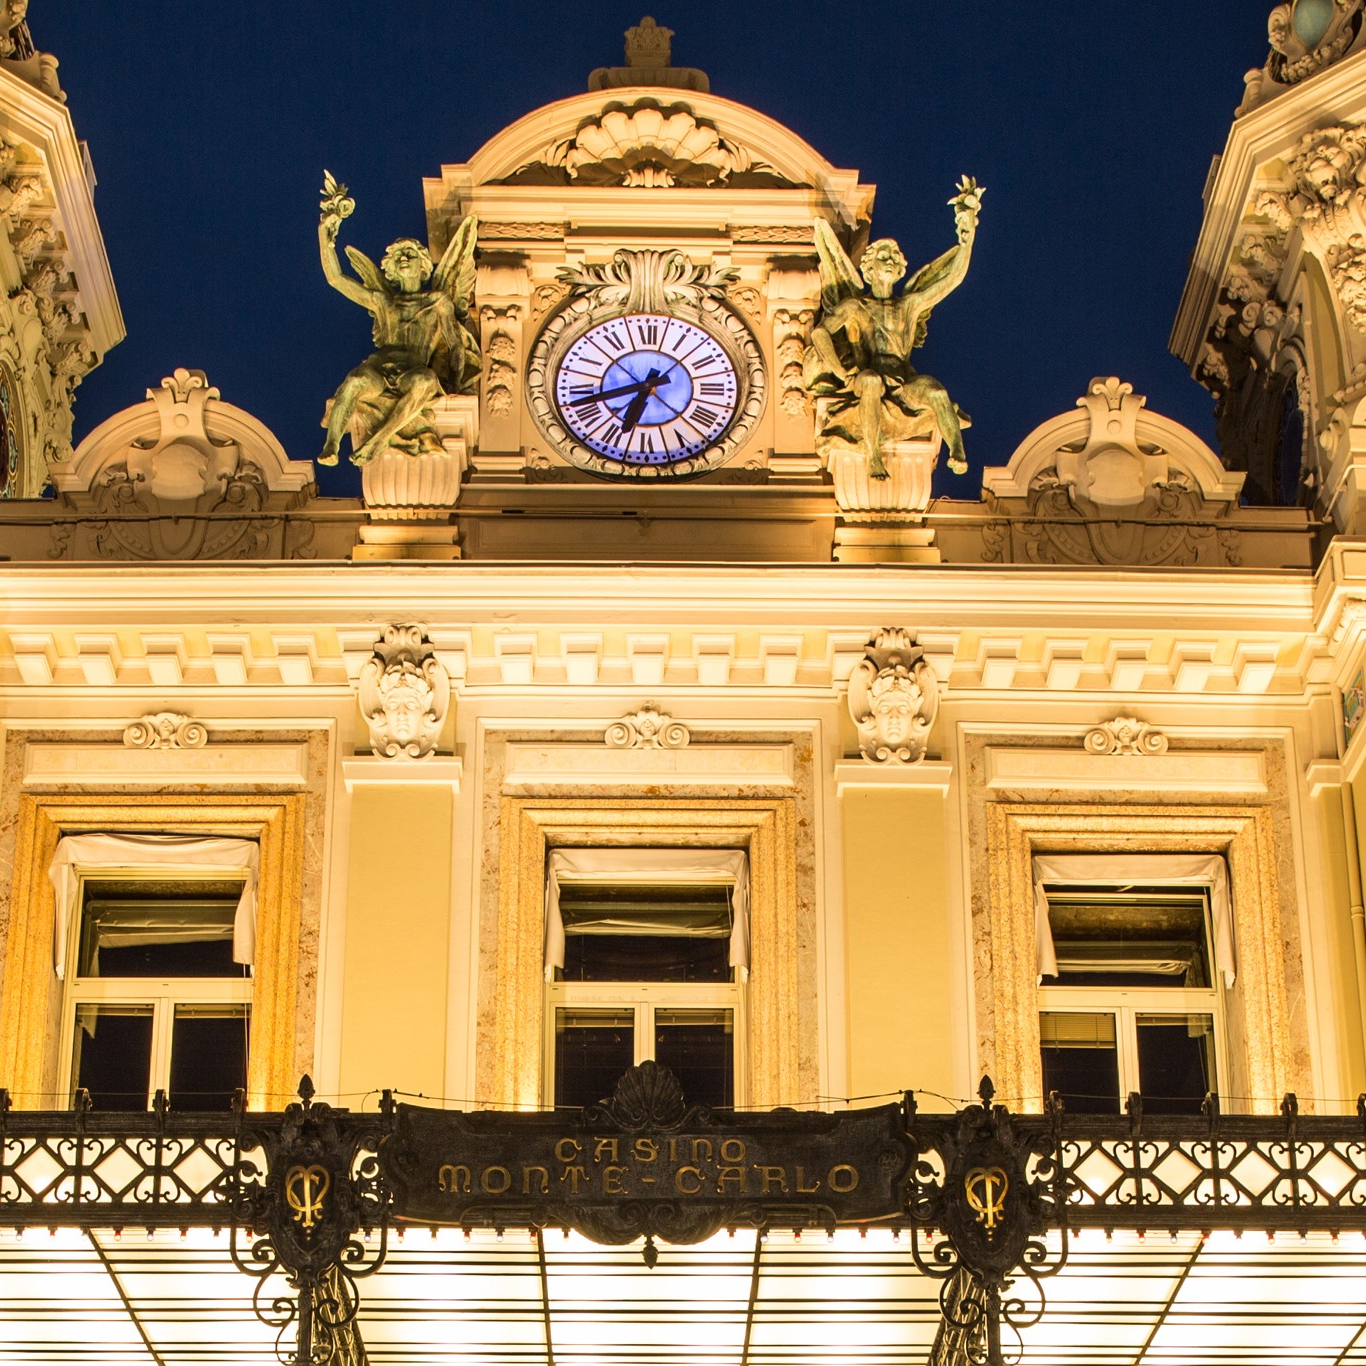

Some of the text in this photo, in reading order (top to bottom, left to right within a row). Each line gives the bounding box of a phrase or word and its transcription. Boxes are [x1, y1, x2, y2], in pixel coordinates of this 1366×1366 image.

[637, 325, 657, 345] XII
[673, 334, 687, 351] I
[692, 354, 716, 371] II
[700, 383, 724, 396] III
[690, 404, 719, 429] IIII
[554, 1137, 747, 1162] CASINO
